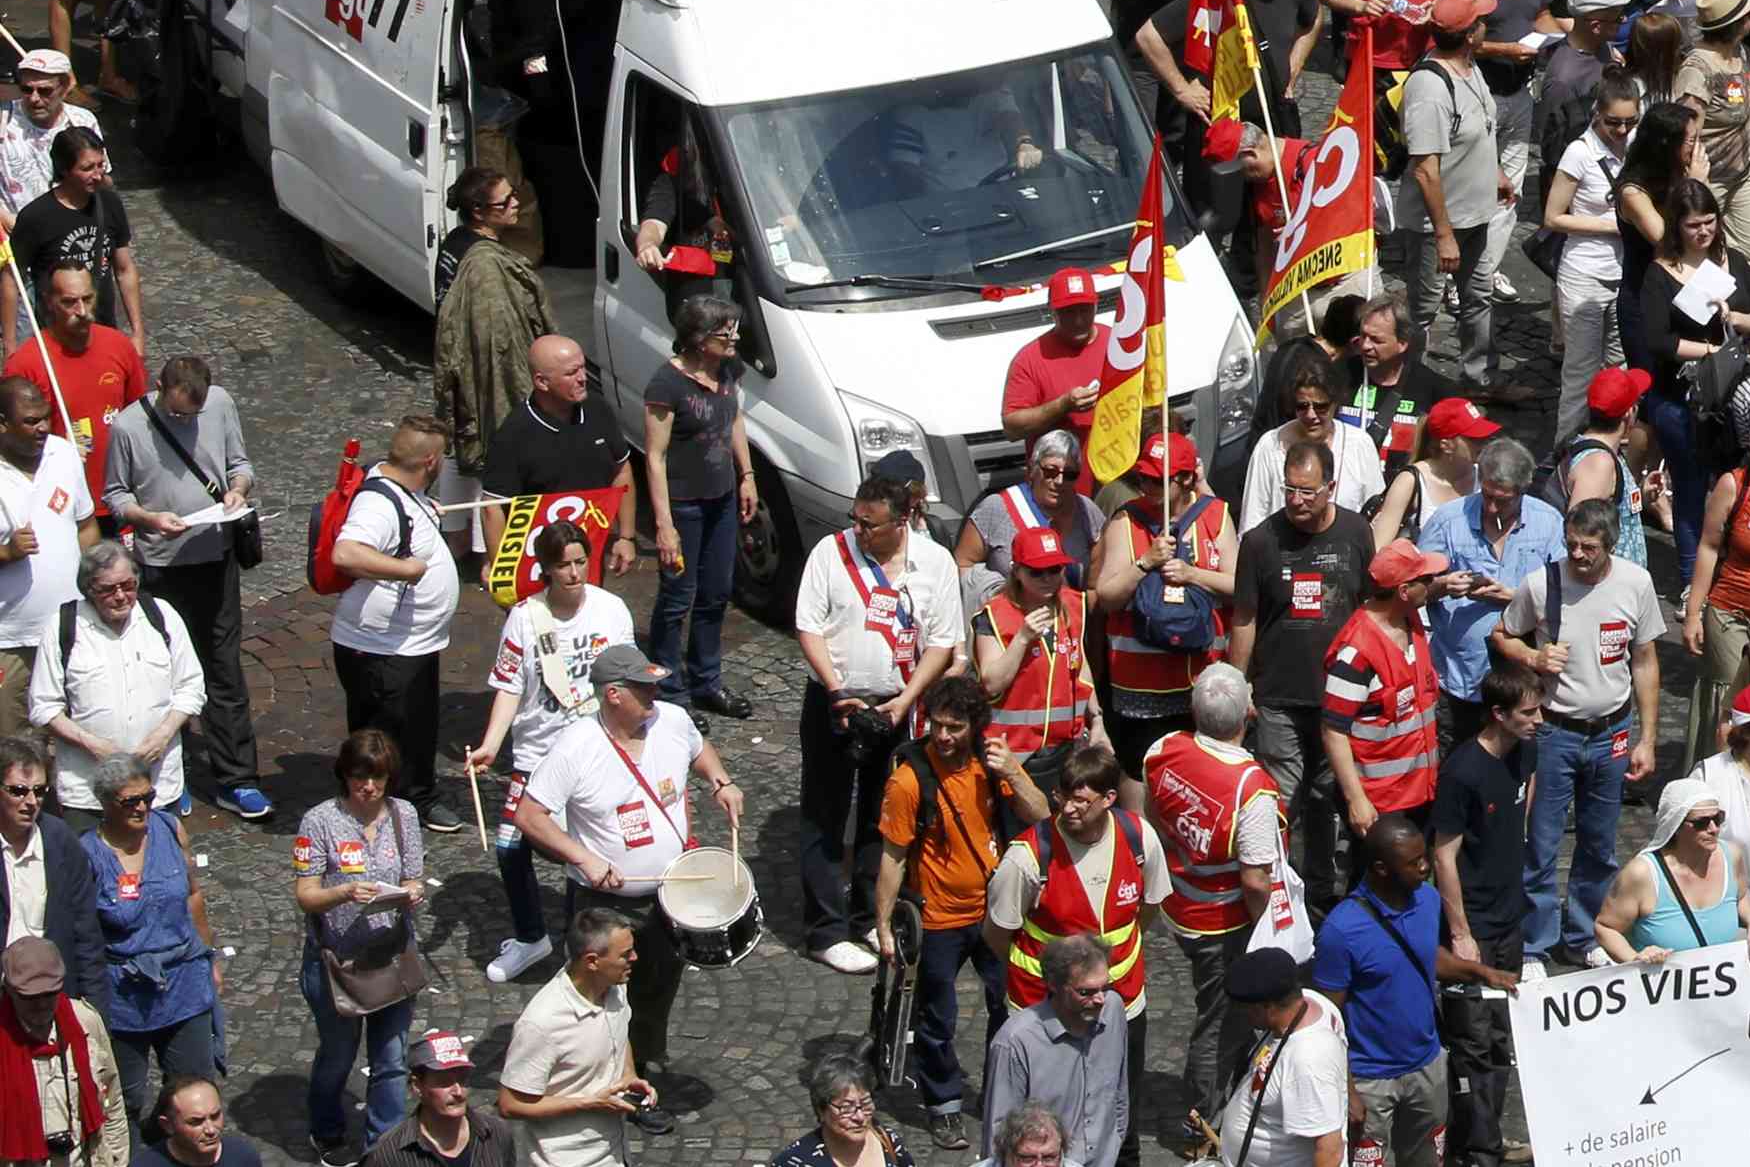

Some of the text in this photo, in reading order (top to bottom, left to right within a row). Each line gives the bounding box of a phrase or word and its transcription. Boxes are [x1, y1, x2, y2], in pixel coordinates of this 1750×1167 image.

[492, 495, 535, 594] NOISIEL
[294, 845, 311, 860] cgt
[1176, 816, 1211, 854] cgt
[340, 847, 365, 865] cgt
[1542, 978, 1627, 1032] NOS
[1640, 961, 1738, 1006] VIES
[1563, 1116, 1668, 1156] + de salaire
